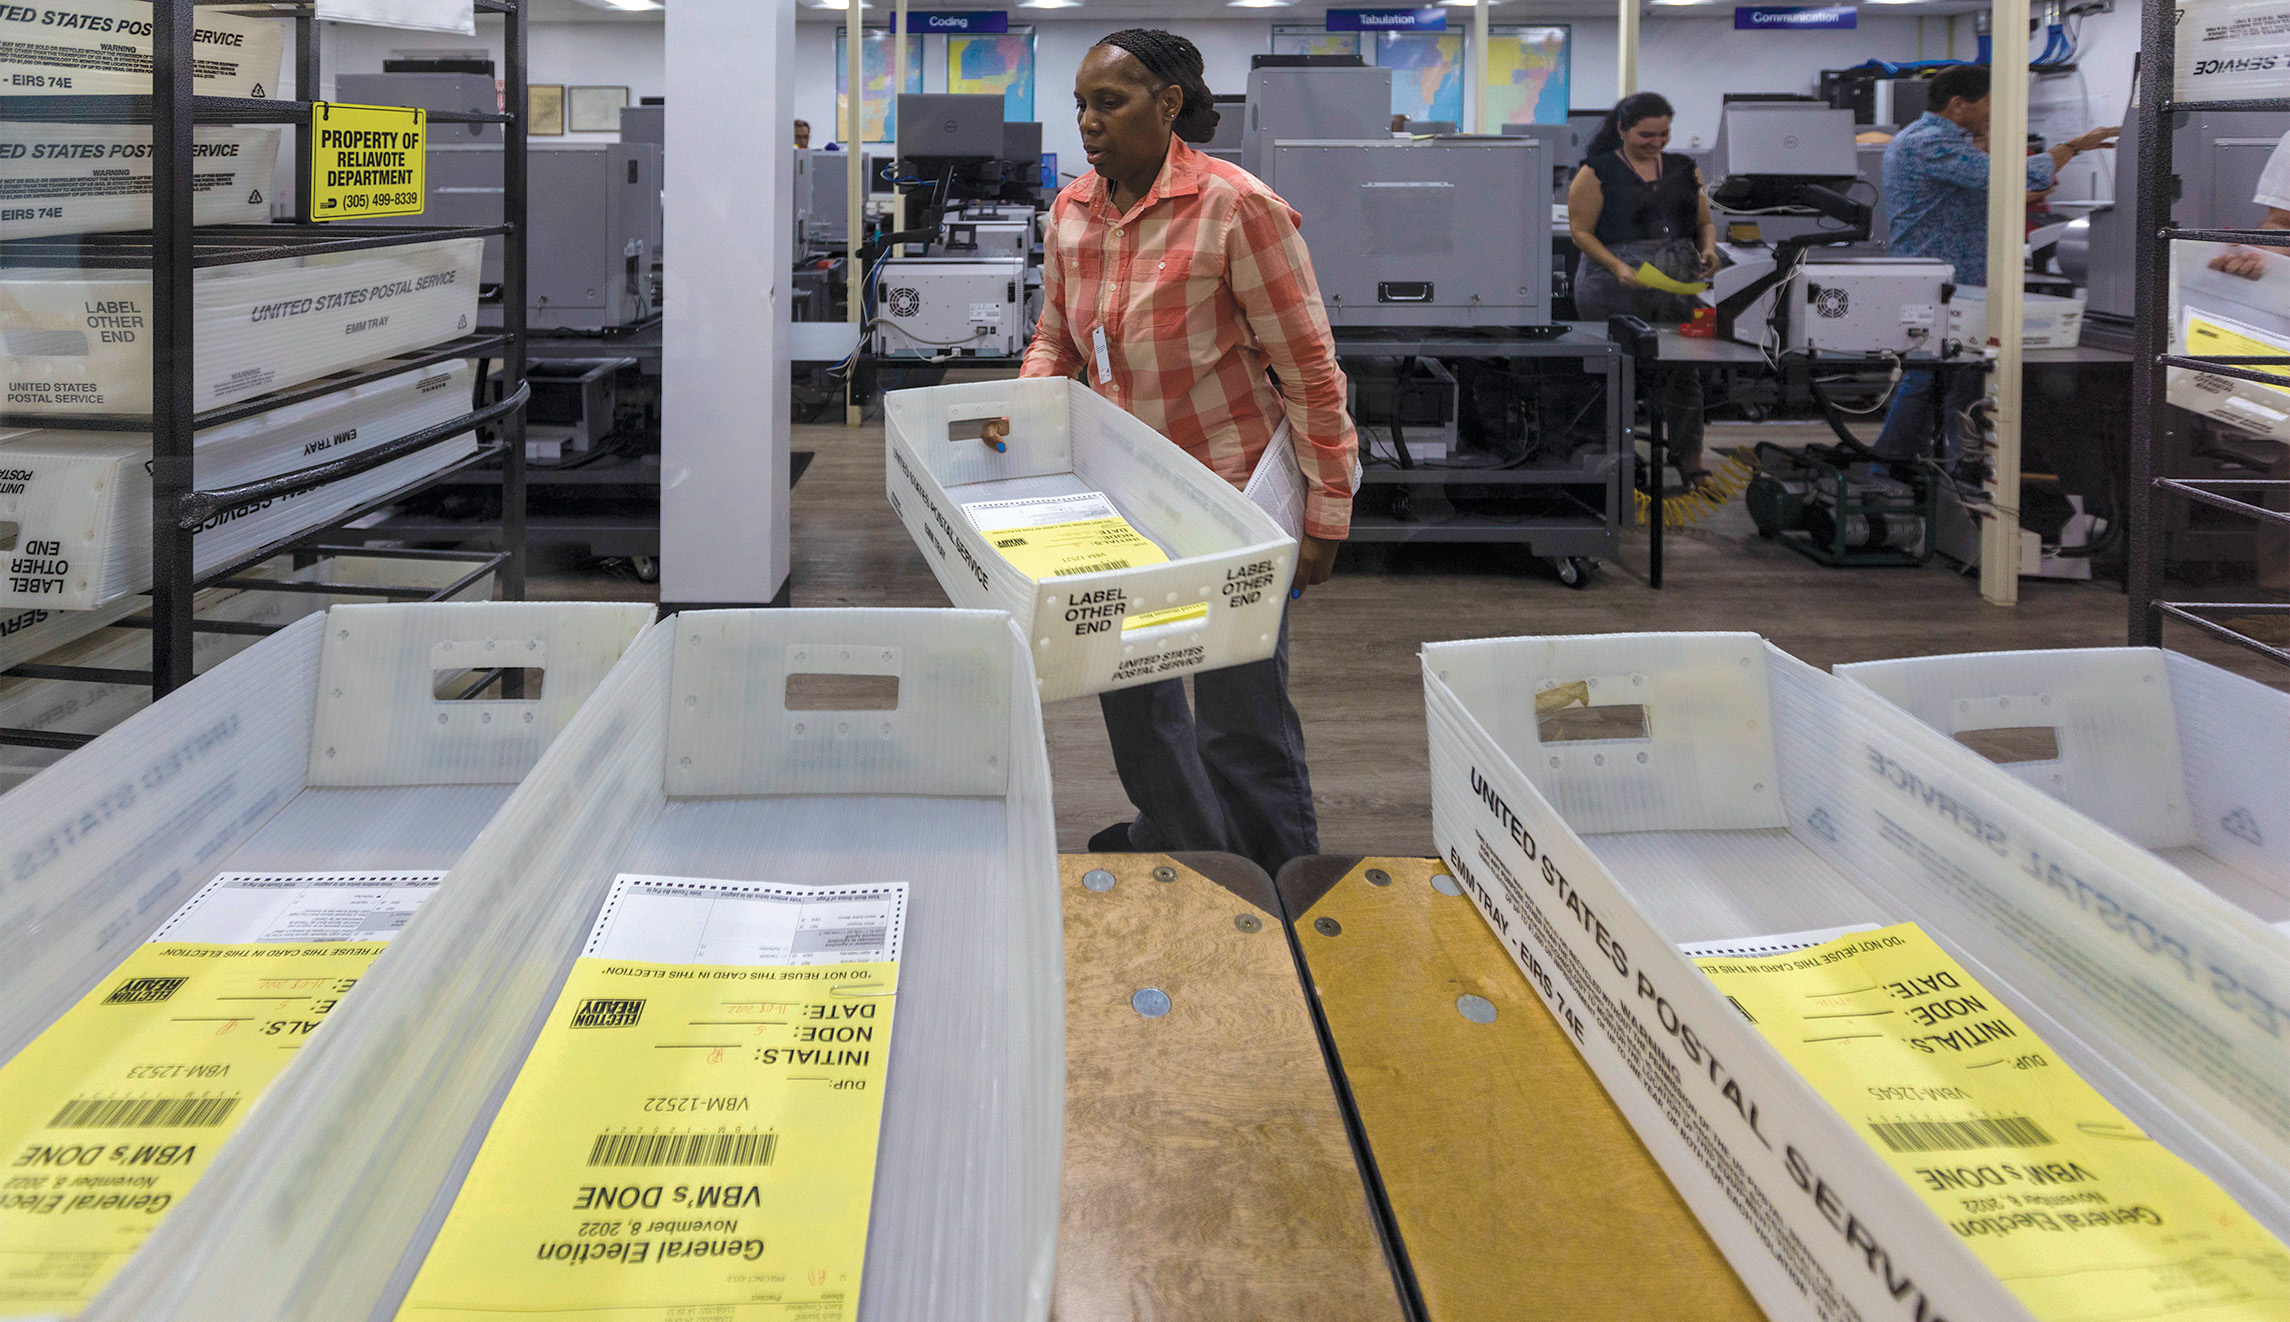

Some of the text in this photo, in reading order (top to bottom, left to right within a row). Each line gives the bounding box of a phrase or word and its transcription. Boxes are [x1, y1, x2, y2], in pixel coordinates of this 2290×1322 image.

[929, 16, 968, 28] Coding
[1360, 14, 1415, 25] Tabulation
[1753, 12, 1839, 23] Communication
[0, 5, 244, 47] TED STATES POS ERVICE
[100, 43, 136, 54] WARNING
[2193, 56, 2278, 75] SERVICE
[12, 75, 72, 89] EIRS 74E
[321, 129, 419, 149] PROPERTY OF
[32, 144, 107, 159] STATES
[109, 144, 153, 158] POST
[193, 144, 239, 157] ERVICE
[337, 151, 405, 167] RELIAVOTE
[93, 169, 130, 177] WARNING
[327, 170, 413, 187] DEPARTMENT
[343, 194, 369, 211] (305)
[372, 192, 418, 206] 499-8339
[2, 207, 63, 221] EIRS 74E
[251, 269, 457, 323] UNITED STATES POSTAL SERVICE
[85, 301, 141, 314] LABEL
[86, 316, 144, 329] OTHER
[345, 315, 390, 335] EMM TRAY
[100, 330, 136, 343] END
[231, 367, 261, 380] WARNING
[9, 382, 97, 393] UNITED STATES
[7, 393, 105, 404] POSTAL SERVICE
[303, 428, 357, 457] EMM TRAY
[0, 483, 25, 494] UNIT
[893, 446, 909, 478] UNITED
[909, 471, 930, 509] STATES
[930, 502, 956, 546] POSTAL
[955, 537, 989, 591] SERVICE
[26, 540, 61, 556] END
[11, 558, 69, 575] OTHER
[1226, 560, 1275, 581] LABEL
[9, 577, 64, 594] LABEL
[1222, 574, 1274, 596] OTHER
[1069, 588, 1128, 606] LABEL
[1229, 591, 1262, 609] END
[1065, 602, 1126, 622] OTHER
[1075, 619, 1112, 635] END
[1118, 645, 1205, 671] UNITED STATES
[1111, 666, 1155, 682] POSTAL
[224, 949, 250, 958] THIS
[254, 949, 264, 957] IN
[268, 949, 300, 957] CARD
[303, 948, 327, 957] THIS
[330, 948, 370, 956] REUSE
[1451, 846, 1475, 894] EMM
[1477, 882, 1509, 936] TRAY
[1520, 942, 1552, 999] EIRS
[1556, 992, 1585, 1046] 74E
[1857, 939, 1882, 952] NOT
[1471, 766, 1536, 862] UNITED
[1541, 854, 1629, 978] STATES
[1637, 969, 1774, 1152] POSTAL
[1793, 956, 1820, 969] THIS
[1820, 944, 1857, 965] REUSE
[668, 970, 695, 979] THIS
[697, 971, 709, 979] IN
[712, 971, 747, 980] CARD
[749, 971, 777, 980] THIS
[779, 971, 820, 980] REUSE
[823, 971, 847, 980] NOT
[1719, 965, 1747, 975] THIS
[1748, 965, 1759, 975] IN
[1760, 961, 1794, 974] CARD
[122, 979, 182, 992] READY
[1881, 971, 1961, 1001] DATE:
[108, 991, 171, 1003] ELECTION
[578, 1000, 642, 1014] READY
[803, 1004, 876, 1020] DATE:
[1904, 994, 1989, 1028] NODE:
[574, 1013, 637, 1027] ELECTION
[1602, 989, 1645, 1053] WITHOUT THE
[793, 1026, 873, 1042] NODE:
[1619, 997, 1681, 1086] WARNING
[1900, 1019, 2017, 1056] INITIALS:
[754, 1048, 870, 1066] INITIALS:
[2005, 1054, 2049, 1072] DUP:
[126, 1065, 230, 1079] VBM-12523
[829, 1079, 867, 1090] DUP:
[1642, 1061, 1681, 1122] LOCATION
[1867, 1086, 1975, 1101] VBM-12645
[643, 1097, 749, 1112] VBM-12522
[12, 1144, 196, 1167] VBM's DONE
[72, 1177, 159, 1190] November
[1627, 1054, 1807, 1299] ONE OR BOTH FOR EACH VIOLATION
[1915, 1164, 2008, 1192] DONE
[64, 1194, 171, 1215] General
[573, 1185, 762, 1210] VBM's DONE
[2020, 1191, 2110, 1207] November
[1959, 1198, 1998, 1215] 2022
[578, 1219, 738, 1236] November 8, 2022
[1949, 1205, 2163, 1239] General Election
[536, 1239, 765, 1266] General Election
